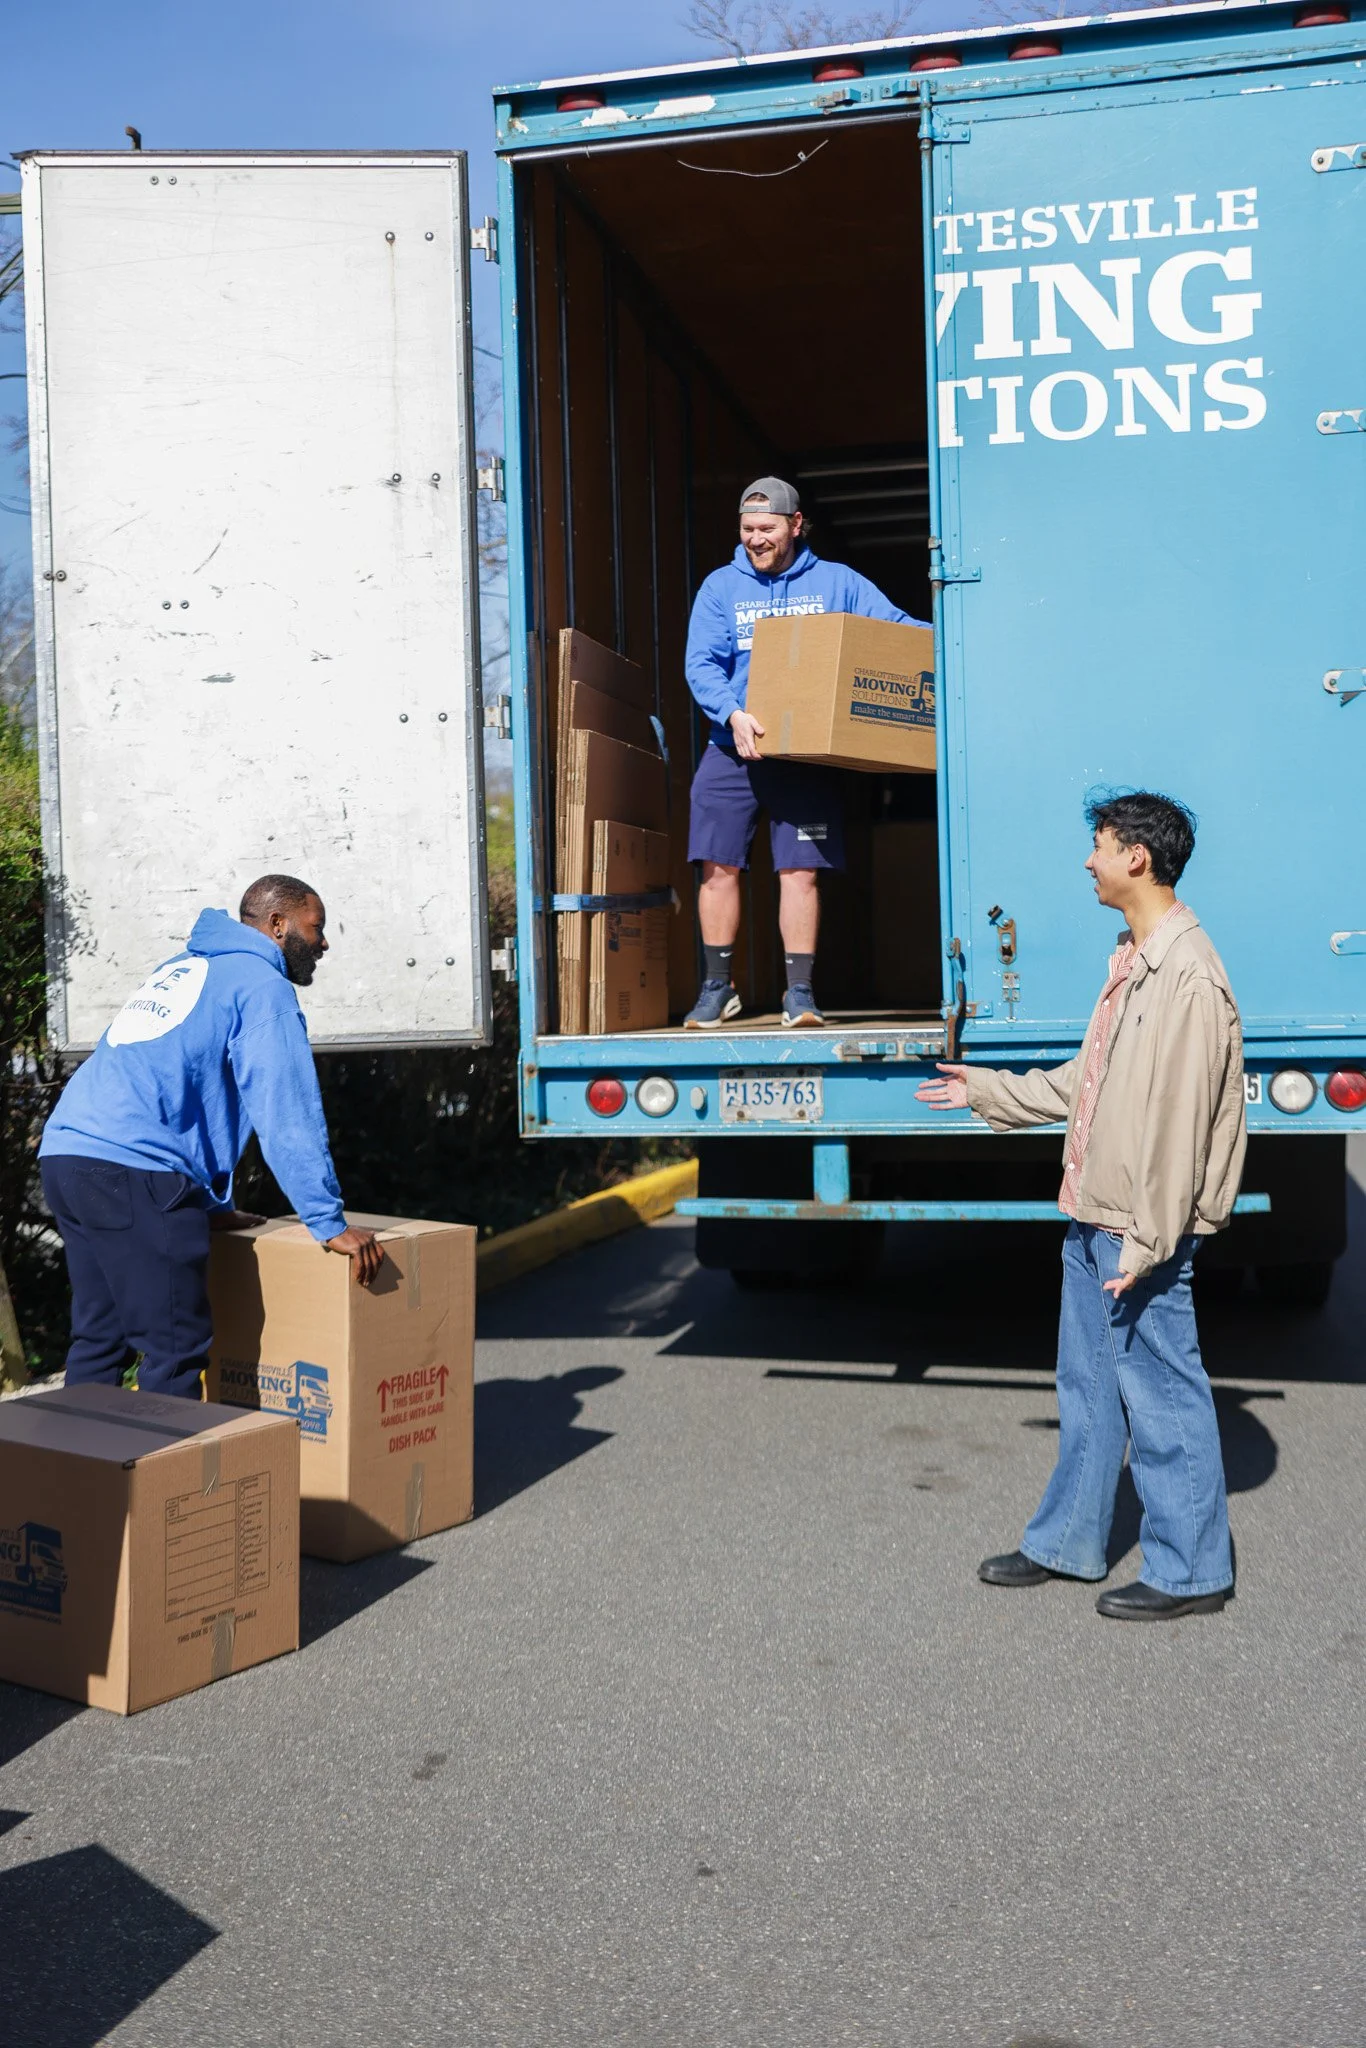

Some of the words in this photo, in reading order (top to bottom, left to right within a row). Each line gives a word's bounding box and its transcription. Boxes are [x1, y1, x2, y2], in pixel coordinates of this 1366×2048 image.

[933, 186, 1259, 256] TESVILLE
[937, 356, 1267, 448] TIONS
[853, 676, 917, 697] MOVING
[854, 667, 918, 684] CHARLOTTESVILLE
[851, 689, 908, 707] SOLUTIONS
[854, 705, 877, 716] make
[878, 708, 891, 718] the
[892, 711, 915, 722] smart
[741, 1081, 816, 1105] 135-763
[220, 1368, 292, 1394] MOVING
[390, 1367, 436, 1395] FRAGILE
[392, 1396, 408, 1410] THIS
[409, 1391, 424, 1406] SIDE
[425, 1388, 435, 1401] UP
[381, 1411, 408, 1428] HANDLE
[409, 1405, 426, 1421] WITH
[428, 1401, 444, 1416] CARE
[389, 1432, 411, 1453] DISH
[413, 1425, 437, 1446] PACK
